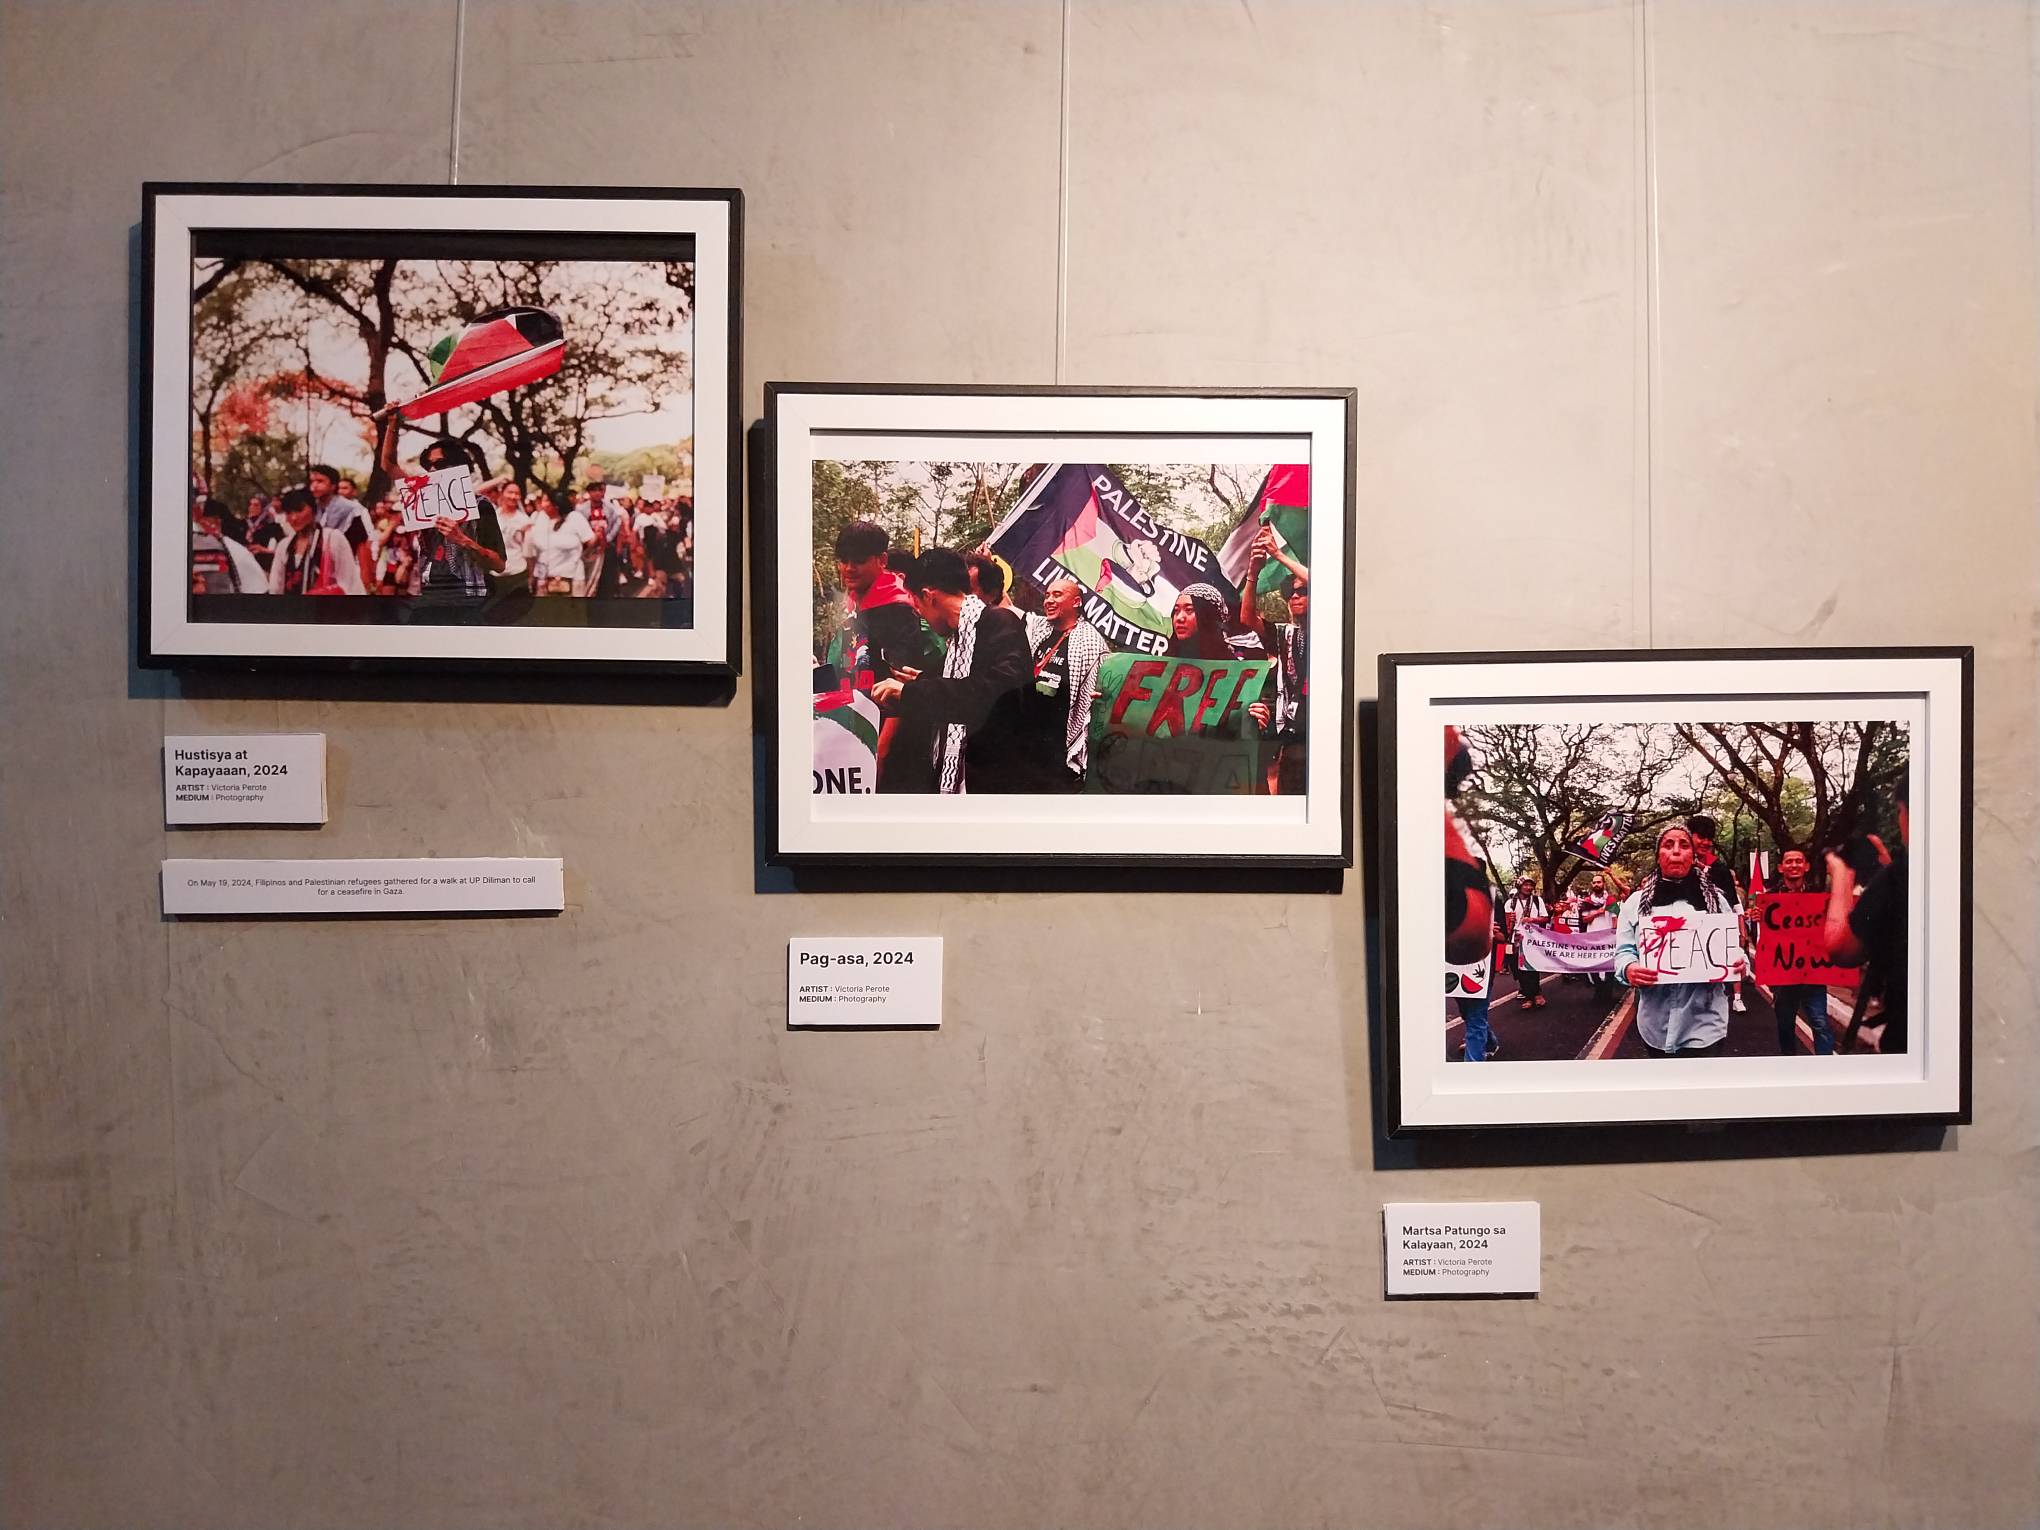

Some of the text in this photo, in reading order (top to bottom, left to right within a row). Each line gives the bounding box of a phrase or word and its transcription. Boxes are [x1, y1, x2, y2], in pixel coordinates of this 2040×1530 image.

[1092, 474, 1209, 573] PALESTINE
[1083, 595, 1169, 657] MATTER
[1108, 660, 1259, 738] FREE
[174, 749, 248, 762] Hustisya at
[175, 764, 289, 778] Kapayaaan, 2024
[175, 784, 205, 792] ARTIST
[211, 784, 240, 792] Victoria
[242, 784, 268, 792] Perote
[215, 793, 264, 803] Photography
[187, 879, 199, 887] On
[200, 879, 217, 888] May
[219, 879, 230, 888] 19,
[231, 879, 254, 888] 2024,
[255, 878, 287, 888] Filipinos
[304, 878, 346, 886] Palestinian
[347, 878, 382, 887] refugees
[383, 877, 419, 887] gathered
[420, 877, 432, 885] for
[439, 877, 458, 885] walk
[459, 877, 467, 885] at
[469, 876, 481, 884] UP
[482, 876, 511, 884] Diliman
[512, 876, 521, 884] to
[522, 876, 536, 884] call
[317, 888, 329, 896] for
[337, 887, 373, 896] ceasefire
[1527, 939, 1569, 950] PALESTINE
[1544, 949, 1558, 957] WE
[1559, 951, 1576, 959] ARE
[799, 952, 914, 968] Pag-asa, 2024
[799, 985, 829, 993] ARTIST
[834, 985, 864, 993] Victoria
[865, 985, 890, 993] Perote
[799, 995, 833, 1003] MEDIUM
[838, 995, 887, 1004] Photography
[1402, 1226, 1506, 1237] Martsa Patungo sa
[1402, 1239, 1489, 1251] Kalayaan, 2024
[1402, 1258, 1432, 1266] ARTIST
[1437, 1258, 1466, 1266] Victoria
[1467, 1258, 1493, 1266] Perote
[1402, 1268, 1436, 1276] MEDIUM
[1442, 1268, 1490, 1277] Photography
